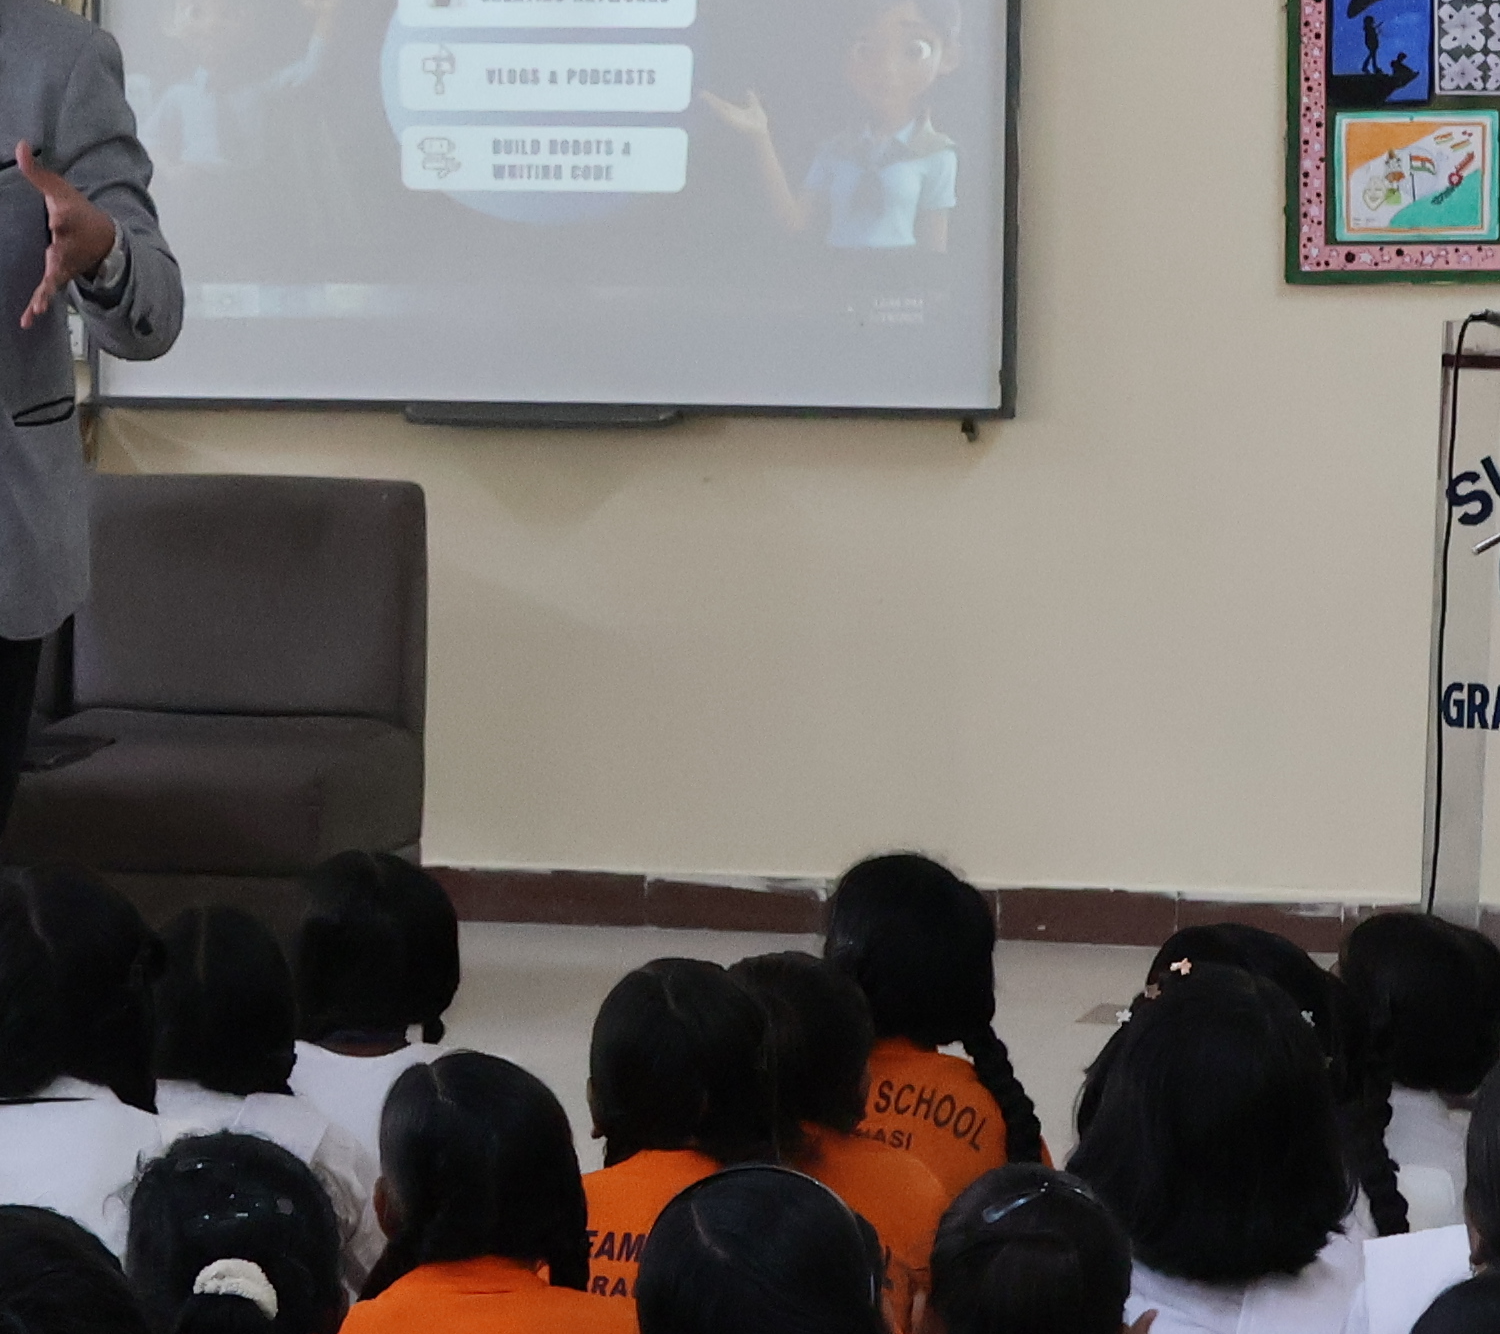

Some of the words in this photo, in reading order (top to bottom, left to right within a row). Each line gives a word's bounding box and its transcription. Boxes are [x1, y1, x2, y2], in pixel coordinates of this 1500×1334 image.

[485, 67, 541, 85] VLOGS
[566, 67, 657, 85] PODCASTS
[492, 138, 541, 155] BUILD
[549, 138, 614, 155] ROBOTS
[492, 164, 563, 181] WRITING
[570, 164, 614, 181] CODE
[873, 1079, 989, 1152] SCHOOL
